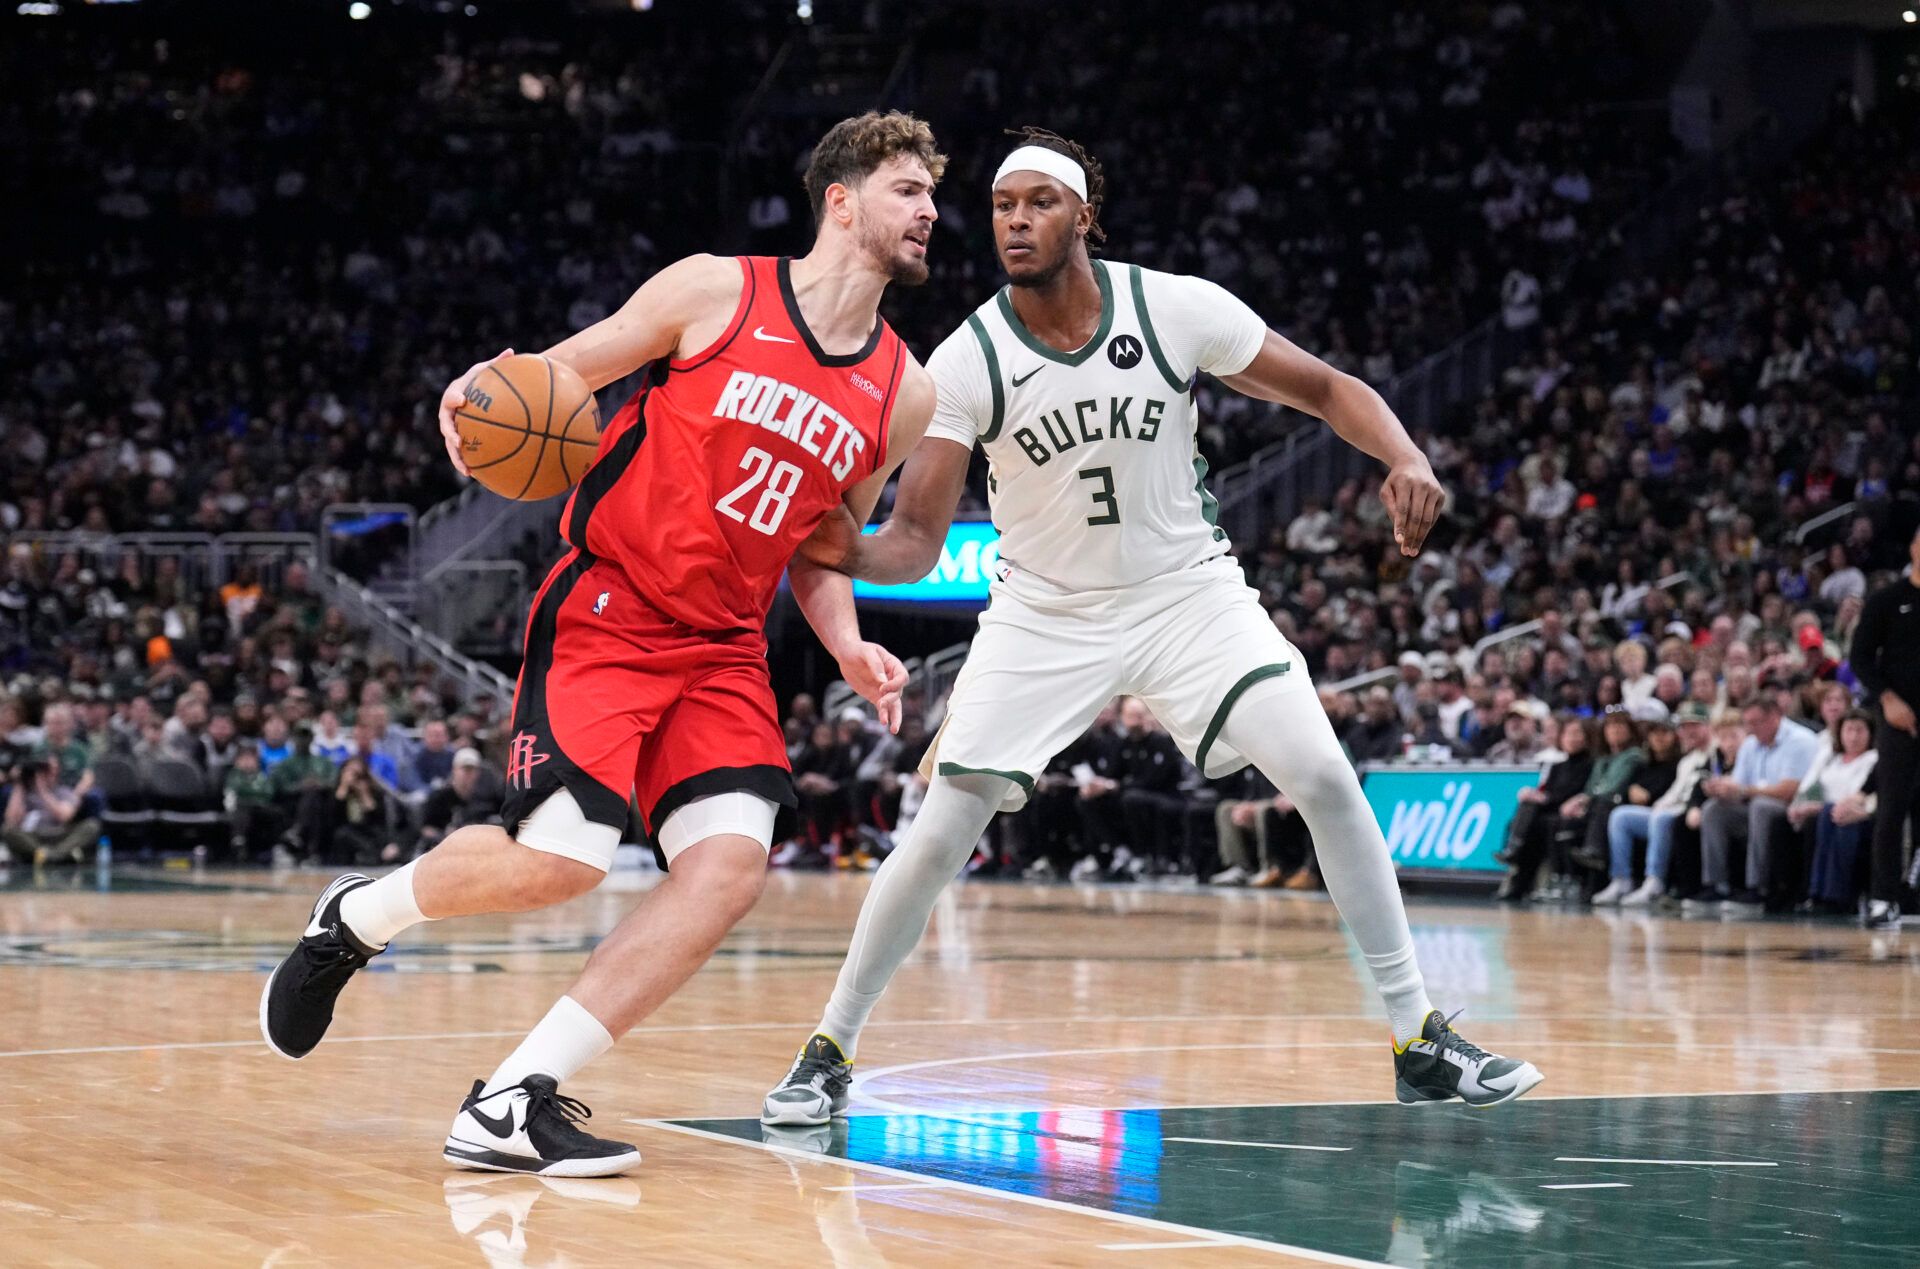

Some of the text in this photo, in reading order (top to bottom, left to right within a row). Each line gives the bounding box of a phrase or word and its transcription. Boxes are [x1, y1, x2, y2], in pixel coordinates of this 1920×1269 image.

[712, 370, 866, 482] ROCKETS
[1013, 397, 1166, 467] BUCKS
[715, 446, 804, 536] 28
[1078, 466, 1121, 526] 3
[1386, 781, 1491, 860] wilo
